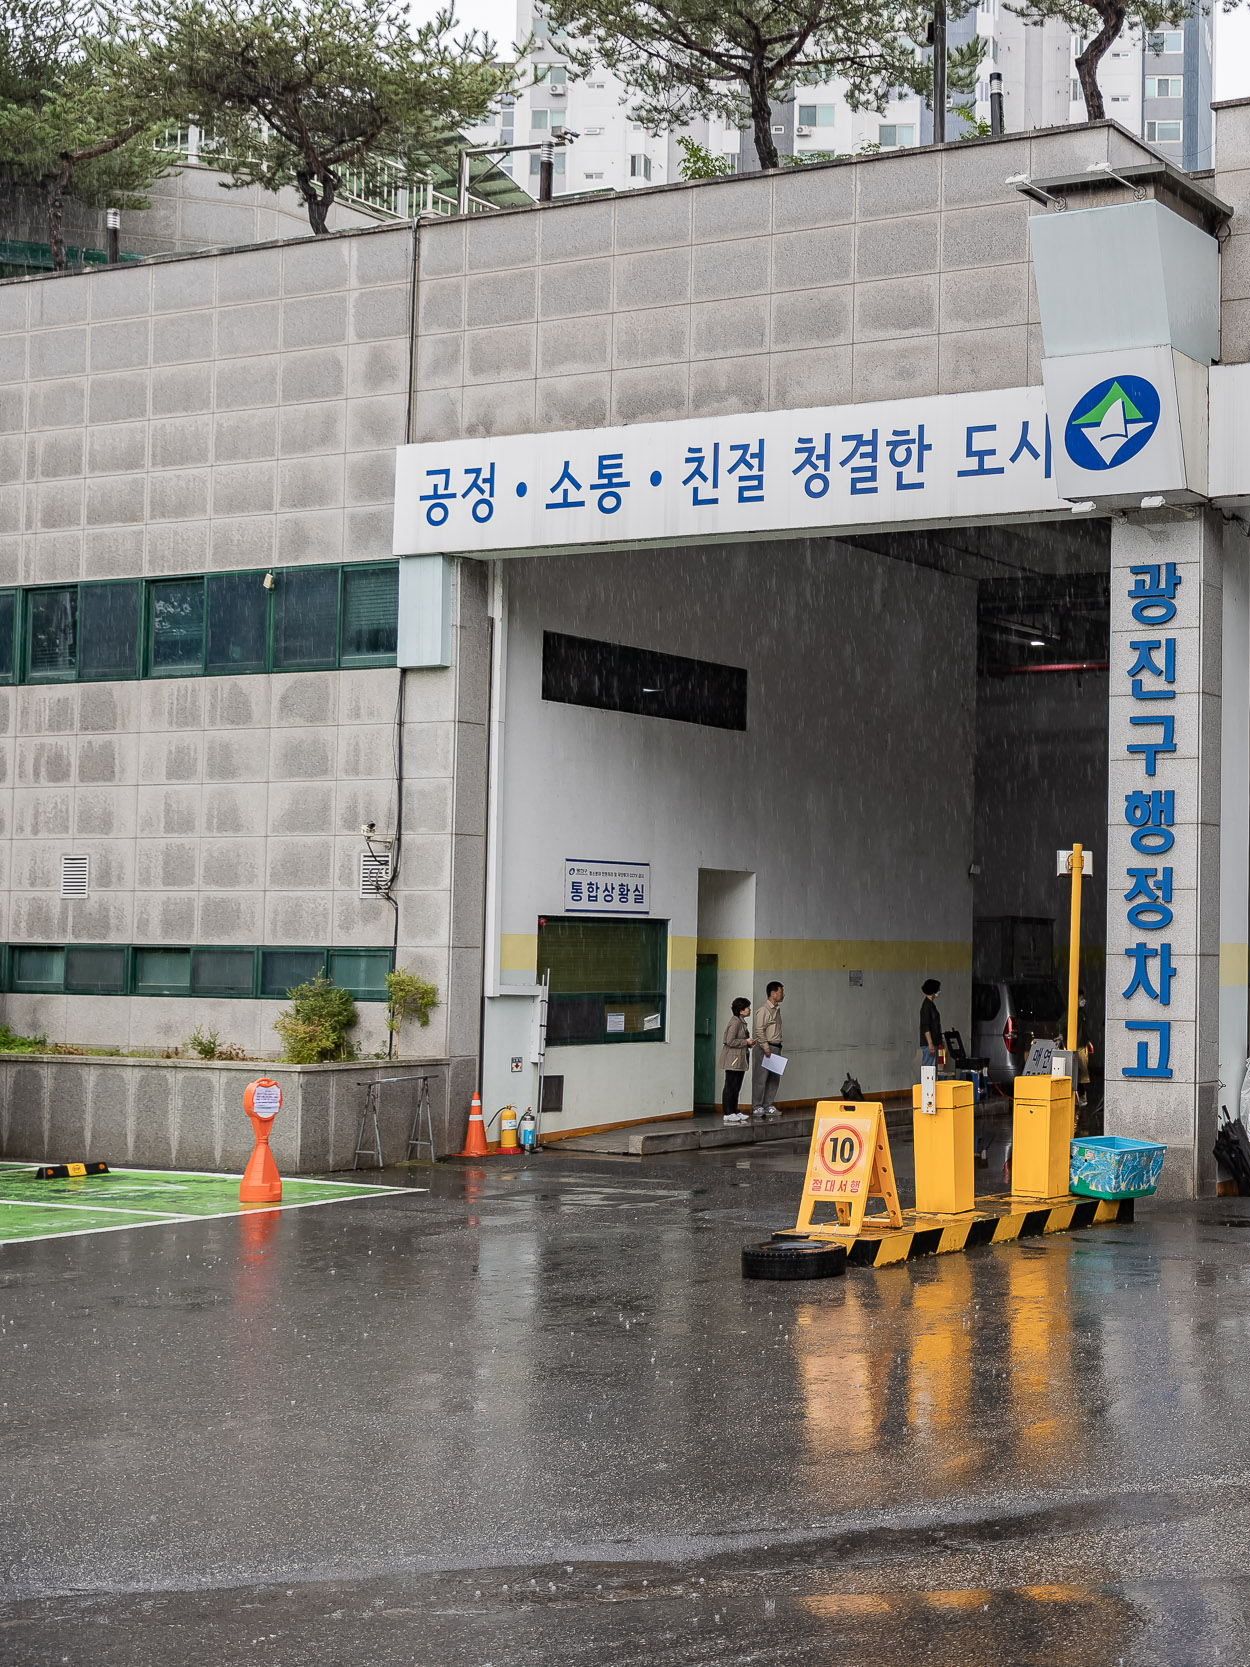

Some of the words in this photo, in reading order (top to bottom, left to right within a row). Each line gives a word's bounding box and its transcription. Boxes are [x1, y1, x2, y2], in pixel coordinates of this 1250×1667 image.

[419, 461, 496, 527] 공정
[544, 453, 632, 516] 소통
[681, 439, 766, 507] 친절
[792, 424, 933, 500] 청결한
[956, 412, 1052, 479] 도시
[1121, 561, 1182, 1079] 광진구행정차고
[570, 881, 645, 904] 통합상황실
[829, 1137, 855, 1163] 10
[811, 1179, 861, 1193] 절대서행
